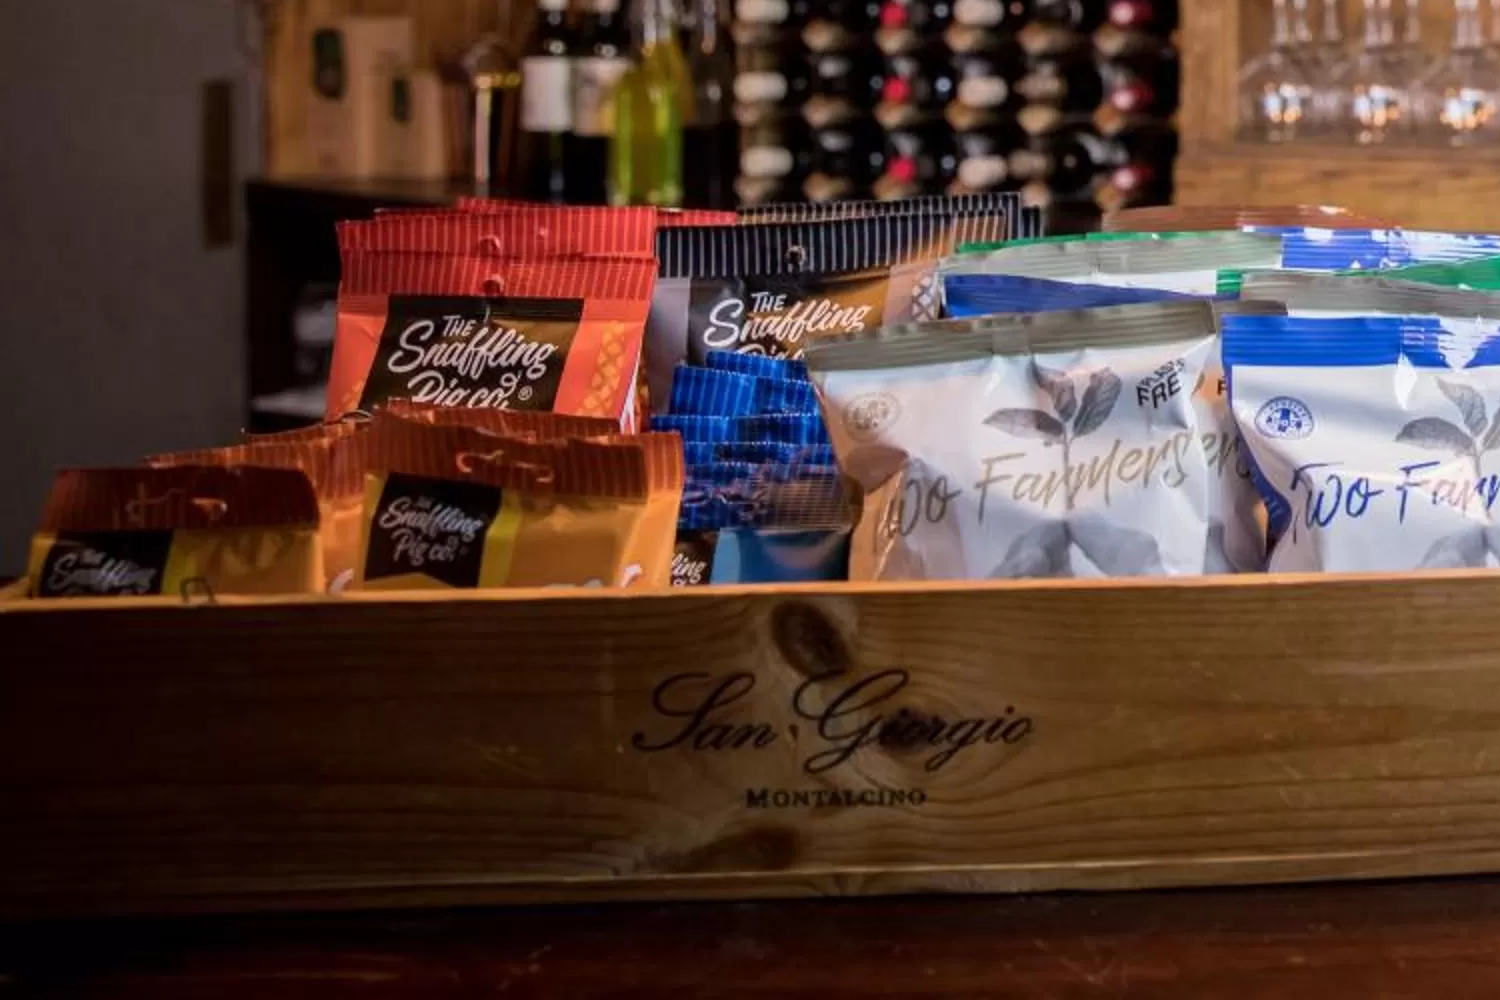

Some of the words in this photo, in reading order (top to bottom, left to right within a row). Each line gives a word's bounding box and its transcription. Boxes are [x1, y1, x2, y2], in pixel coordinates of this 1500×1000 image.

[443, 315, 477, 337] THE
[703, 298, 872, 347] Snaffling
[751, 291, 788, 313] THE
[387, 319, 558, 380] Snaffling
[974, 431, 1195, 525] Farmers
[1291, 461, 1384, 544] Two
[378, 496, 485, 543] Snaffling
[390, 527, 431, 567] Pig
[632, 671, 778, 752] San
[793, 669, 1034, 773] Giorgio
